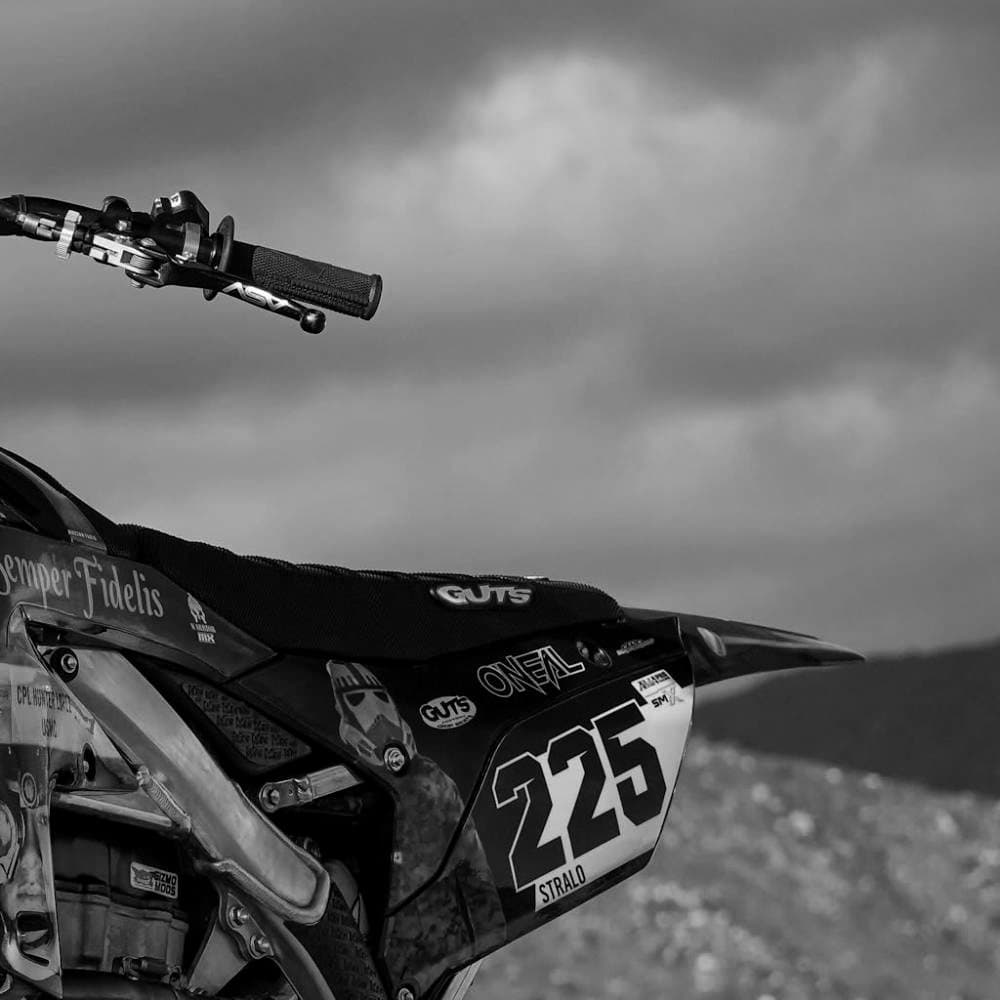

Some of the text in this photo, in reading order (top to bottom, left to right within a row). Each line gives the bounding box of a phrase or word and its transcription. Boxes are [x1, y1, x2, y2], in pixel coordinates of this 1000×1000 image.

[73, 555, 164, 619] Fidelis
[437, 585, 532, 605] GUTS
[420, 698, 470, 722] GUTS
[492, 699, 667, 893] 225
[539, 864, 587, 903] STRALO
